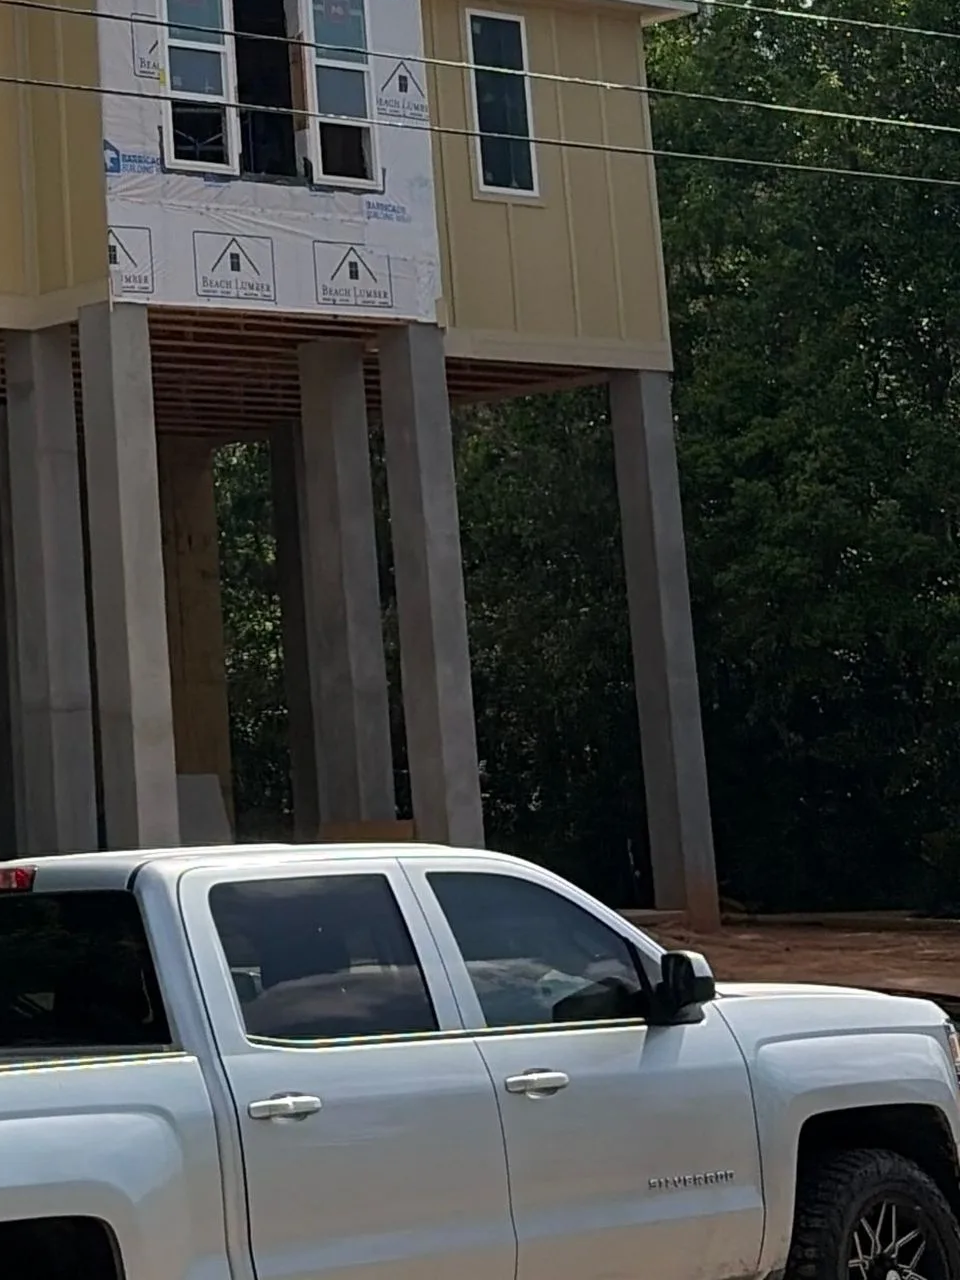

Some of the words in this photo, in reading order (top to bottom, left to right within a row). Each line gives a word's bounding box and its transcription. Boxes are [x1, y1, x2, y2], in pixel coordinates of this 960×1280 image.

[202, 276, 232, 289] BEACH
[234, 277, 271, 292] LUMBER
[321, 284, 351, 297] BEACH
[353, 286, 389, 299] LUMBER
[648, 1170, 734, 1189] SILVERADO
